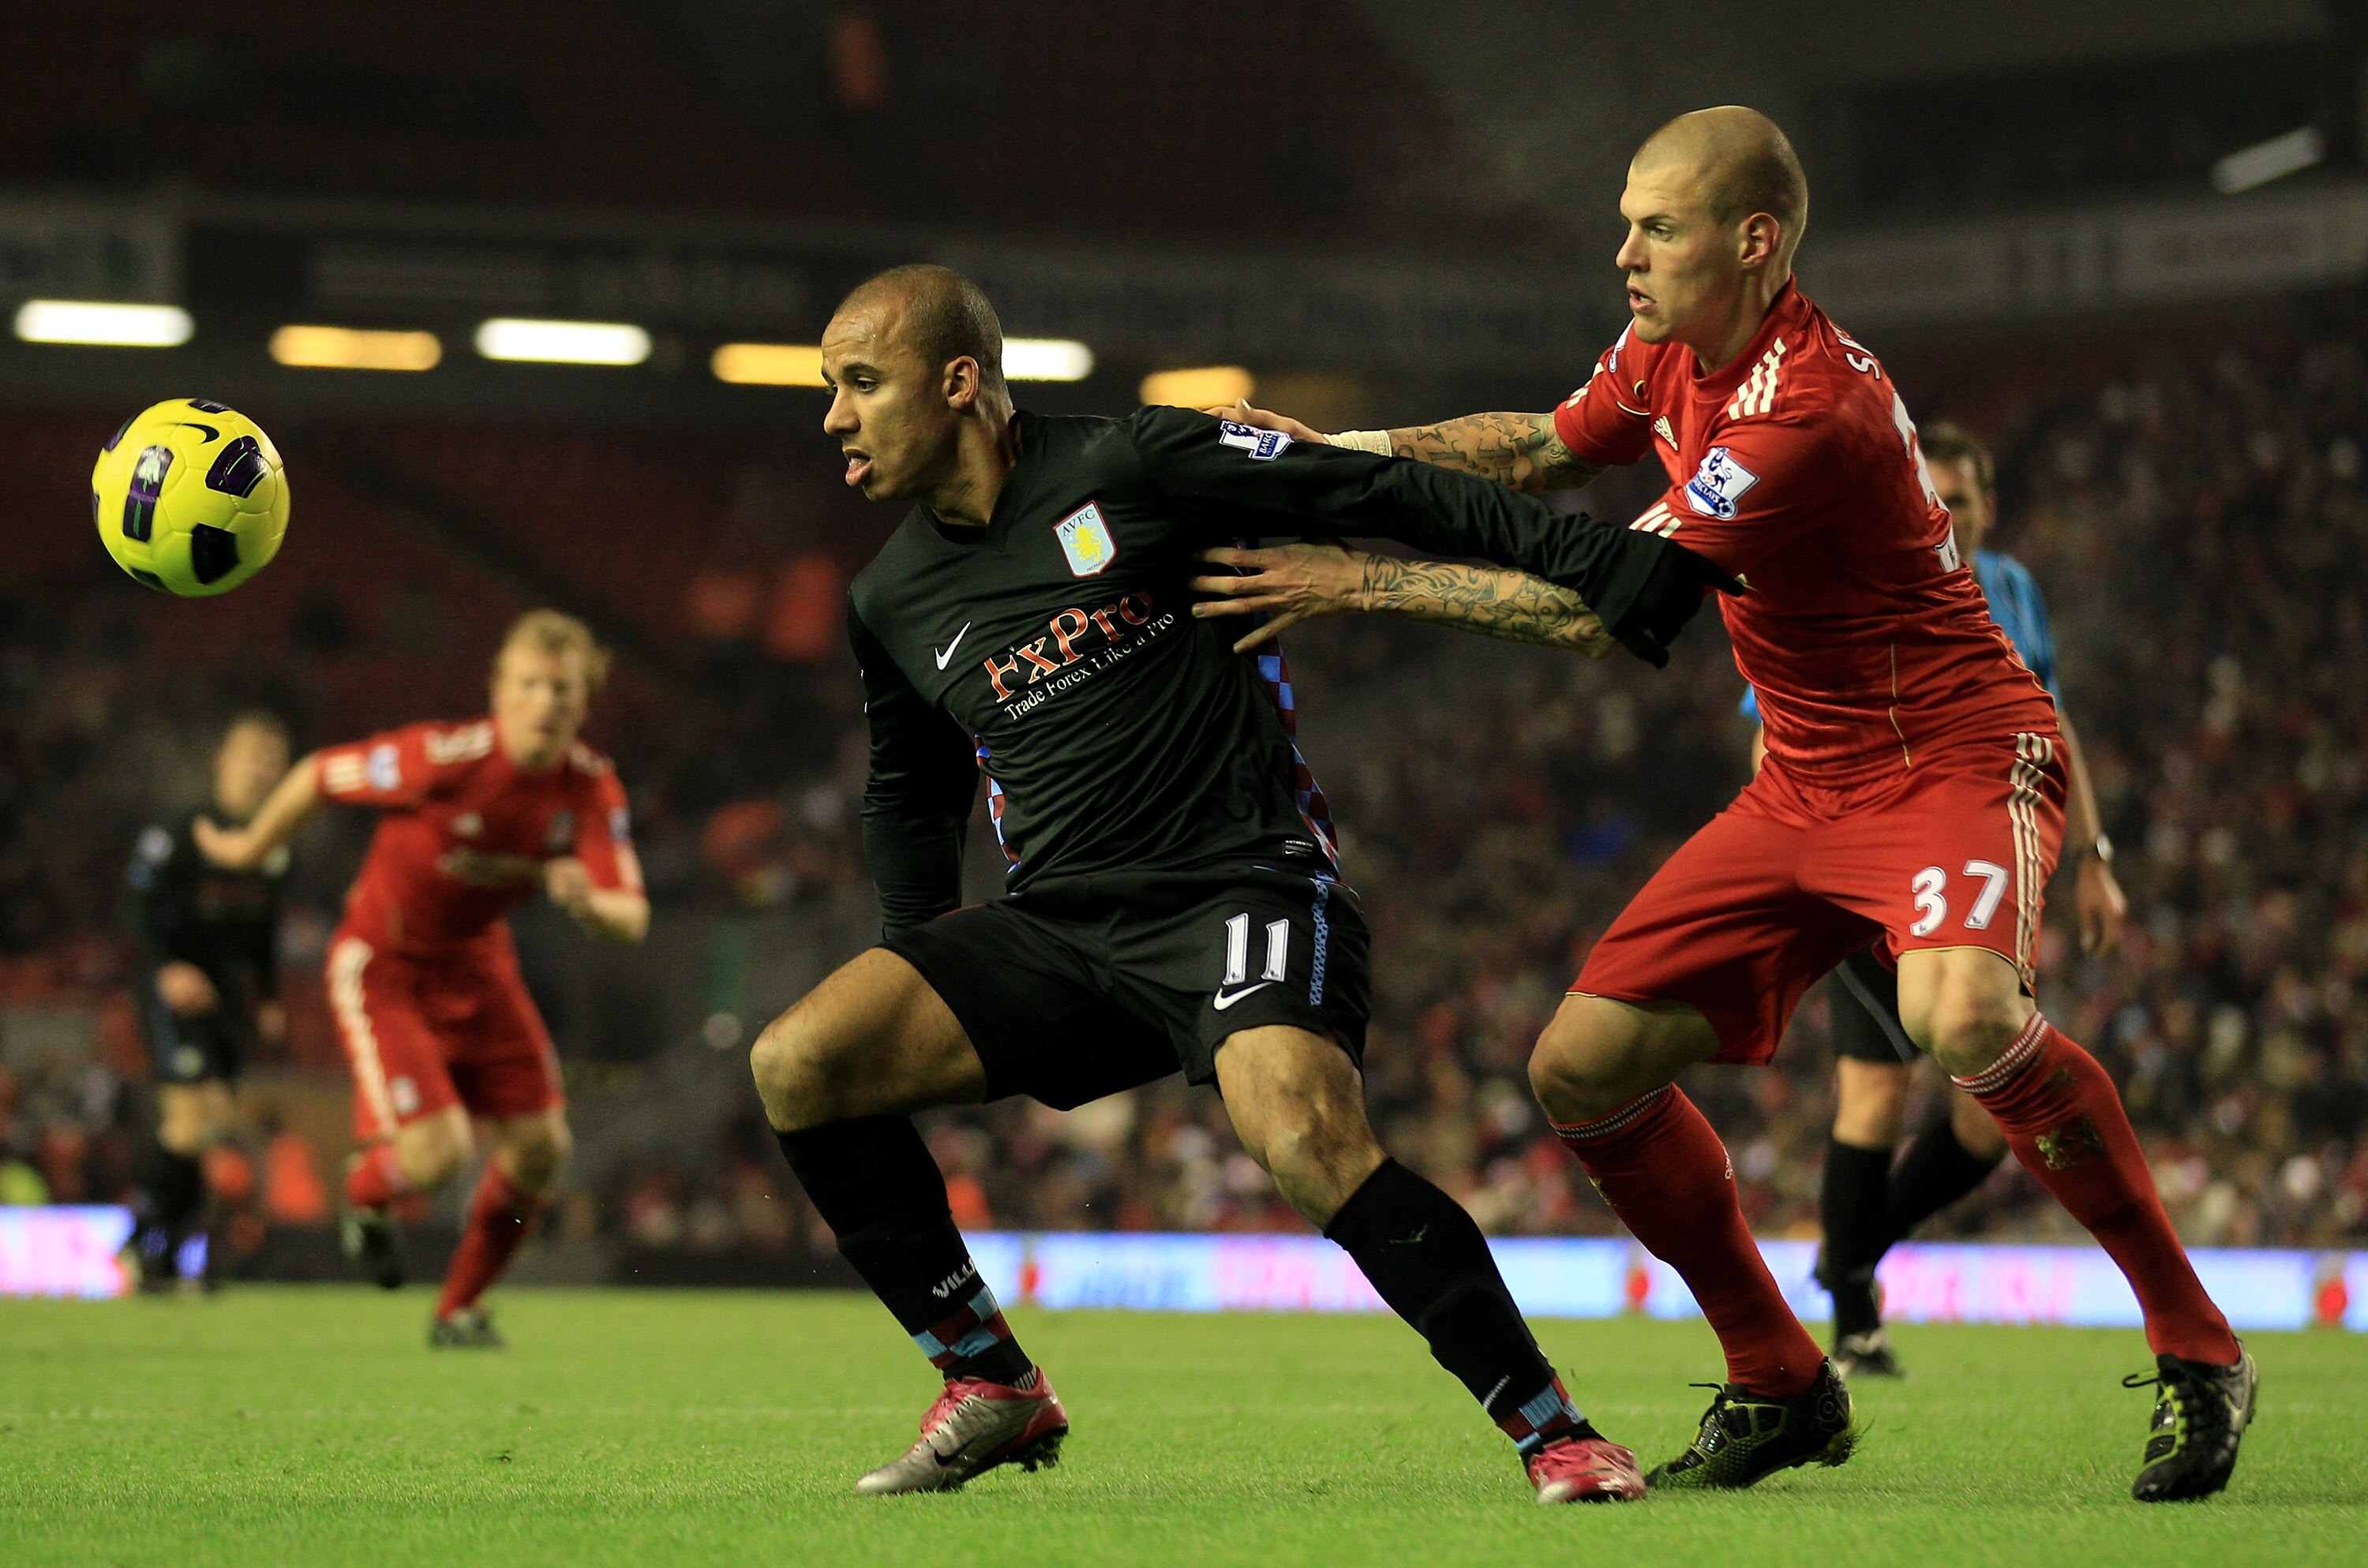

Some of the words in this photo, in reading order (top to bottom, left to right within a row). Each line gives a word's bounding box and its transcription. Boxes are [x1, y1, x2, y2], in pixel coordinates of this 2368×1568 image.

[1062, 509, 1095, 537] AVFC
[984, 592, 1152, 703] FxPro
[1004, 690, 1046, 721] Trade
[1046, 667, 1092, 696] Forex
[1090, 644, 1132, 671] Like
[1137, 634, 1146, 646] a
[1147, 613, 1175, 637] Pro
[1909, 859, 2009, 937] 37
[1222, 912, 1289, 986] 11
